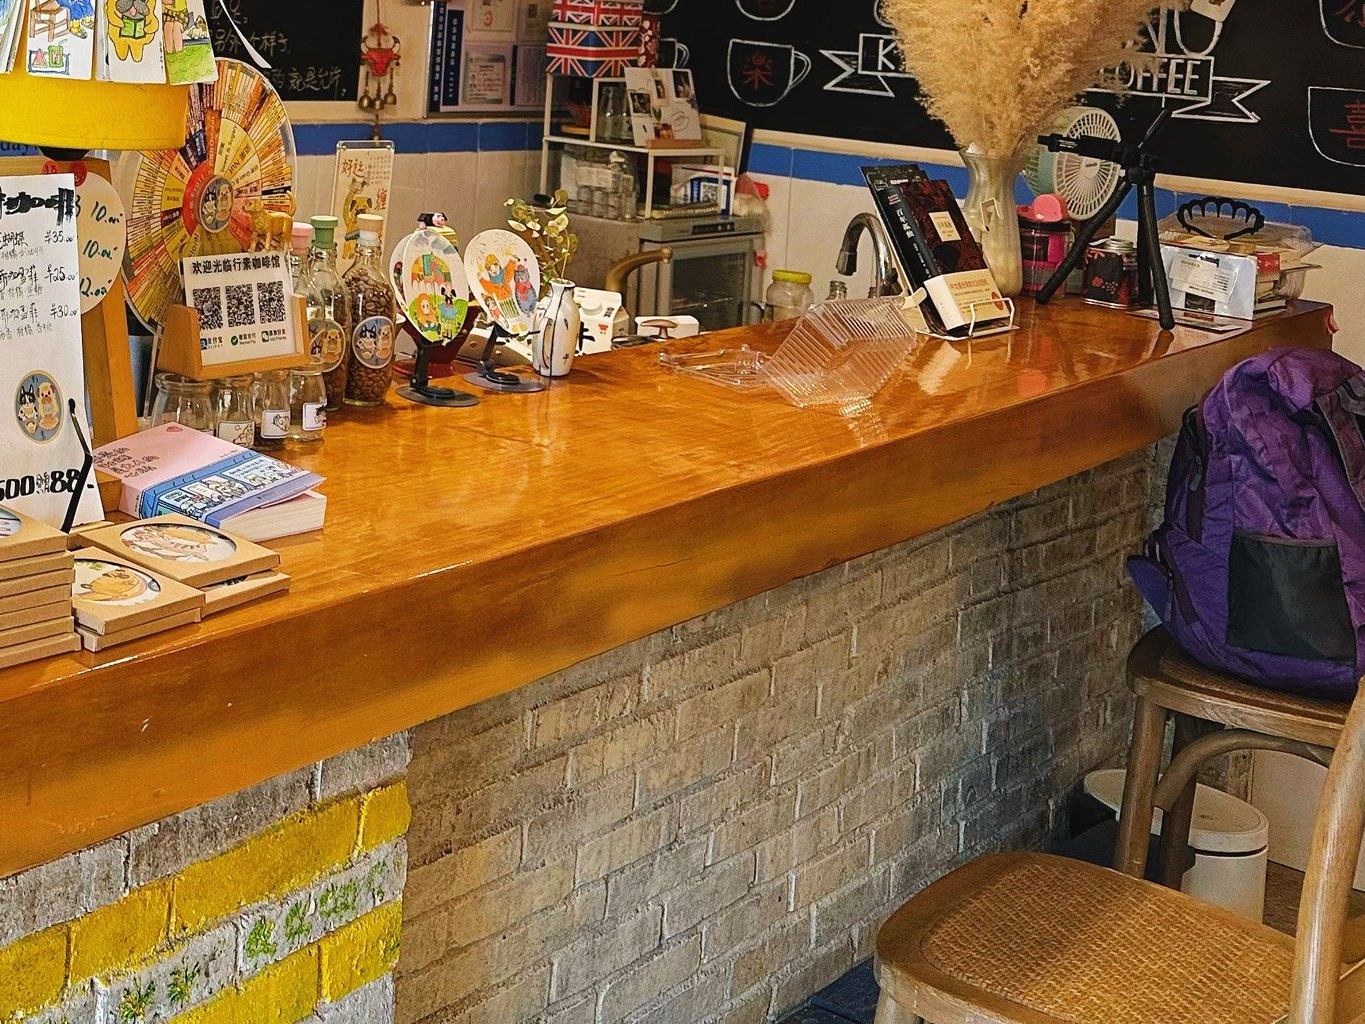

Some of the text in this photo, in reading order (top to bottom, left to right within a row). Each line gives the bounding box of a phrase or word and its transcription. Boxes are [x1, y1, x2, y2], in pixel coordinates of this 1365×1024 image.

[191, 255, 282, 275] 欢迎光临行素咖啡馆
